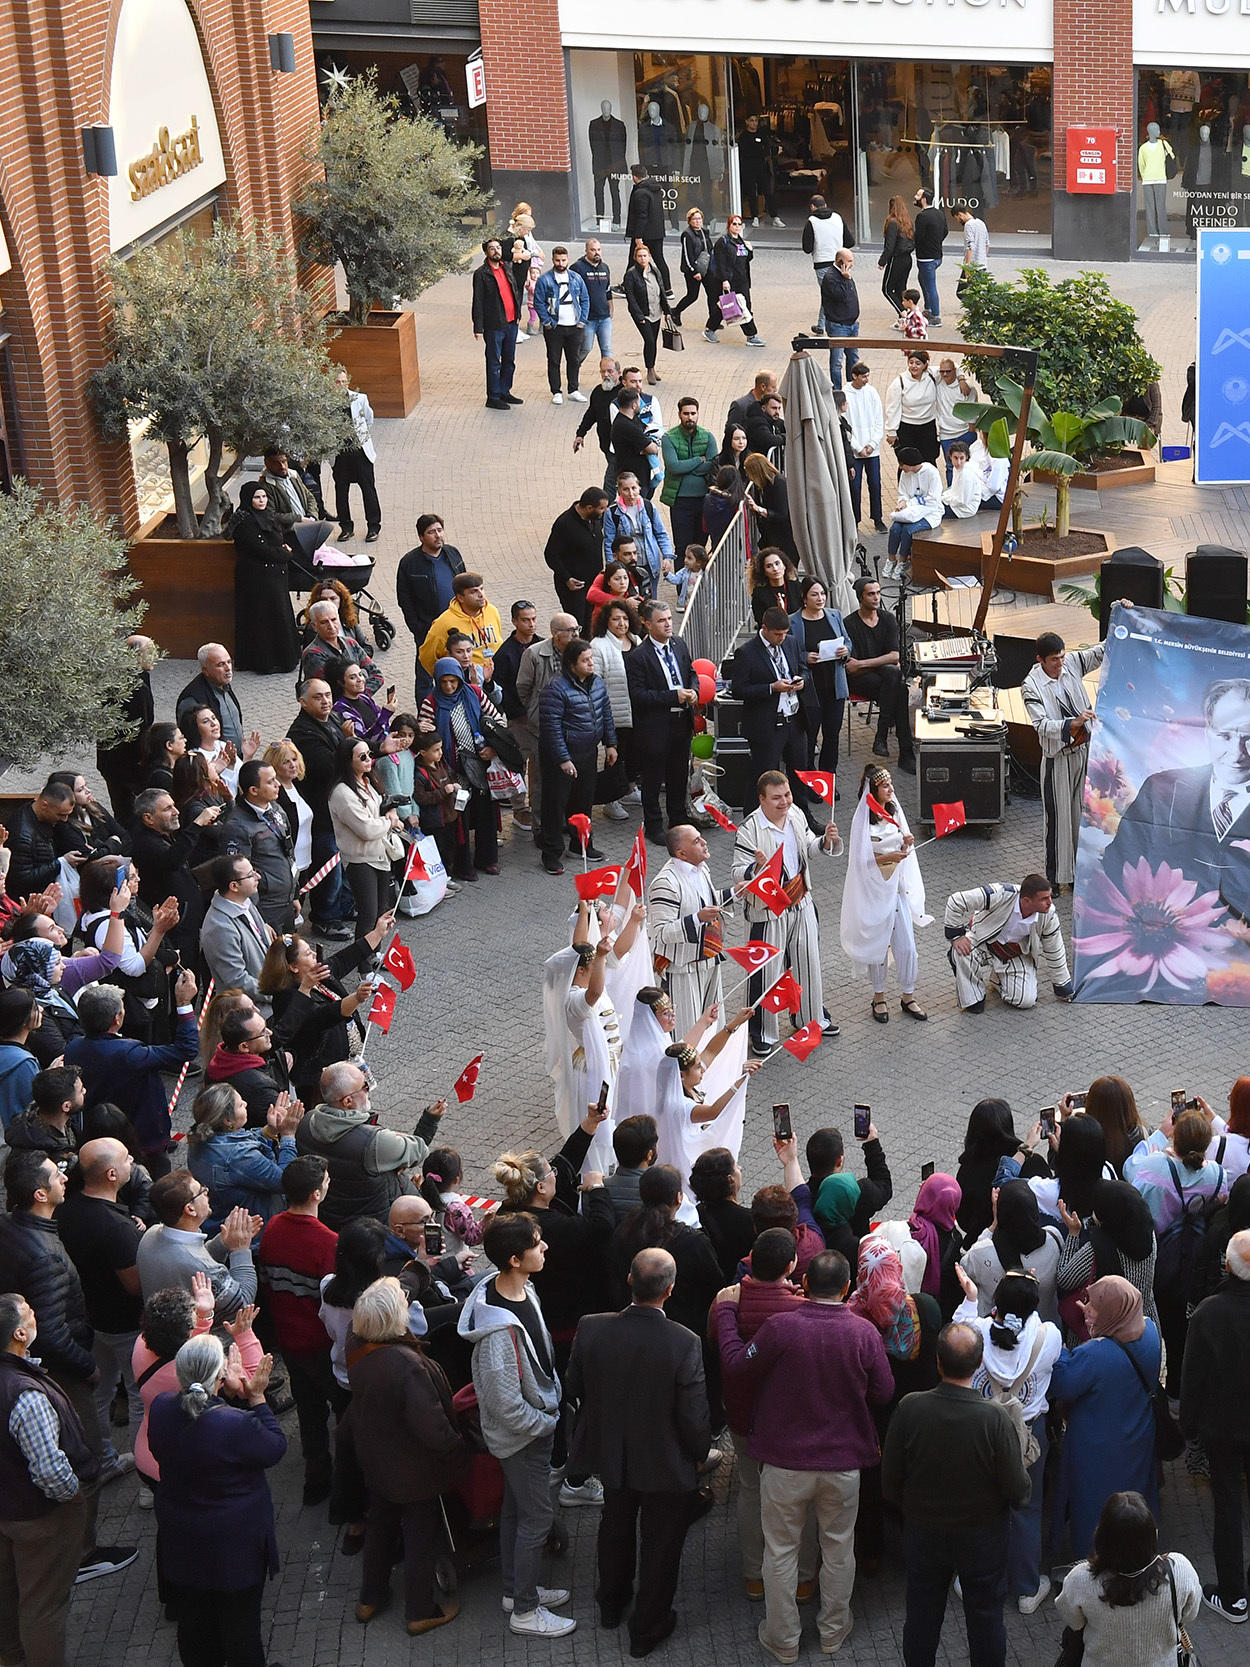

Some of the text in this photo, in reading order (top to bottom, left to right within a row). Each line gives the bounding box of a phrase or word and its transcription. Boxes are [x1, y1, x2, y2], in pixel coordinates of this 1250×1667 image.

[129, 115, 204, 201] saat&saat
[1213, 191, 1230, 199] YENİ
[1231, 191, 1242, 199] BİR
[1190, 204, 1239, 217] MUDO
[1192, 217, 1237, 228] REFINED
[1163, 640, 1183, 649] MERSİN
[1184, 644, 1217, 654] BÜYÜKŞEHİR
[1218, 649, 1246, 658] BELEDİYESİ
